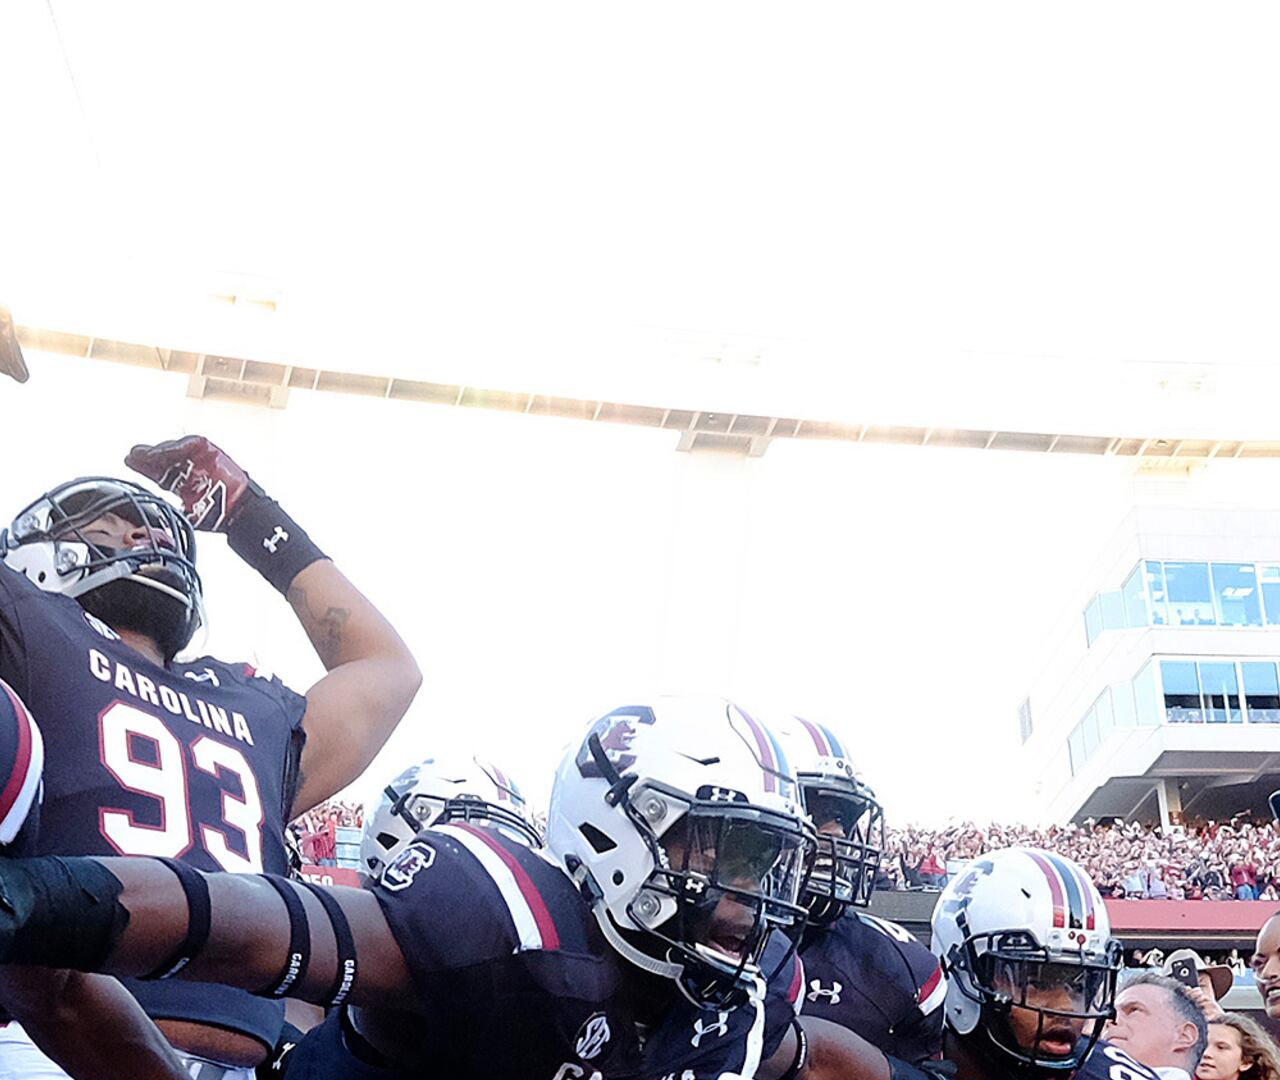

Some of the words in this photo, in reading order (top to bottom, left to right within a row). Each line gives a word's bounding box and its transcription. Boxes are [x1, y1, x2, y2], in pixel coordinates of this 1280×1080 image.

[88, 648, 255, 746] CAROLINA
[97, 699, 266, 875] 93
[575, 1016, 611, 1060] SEC
